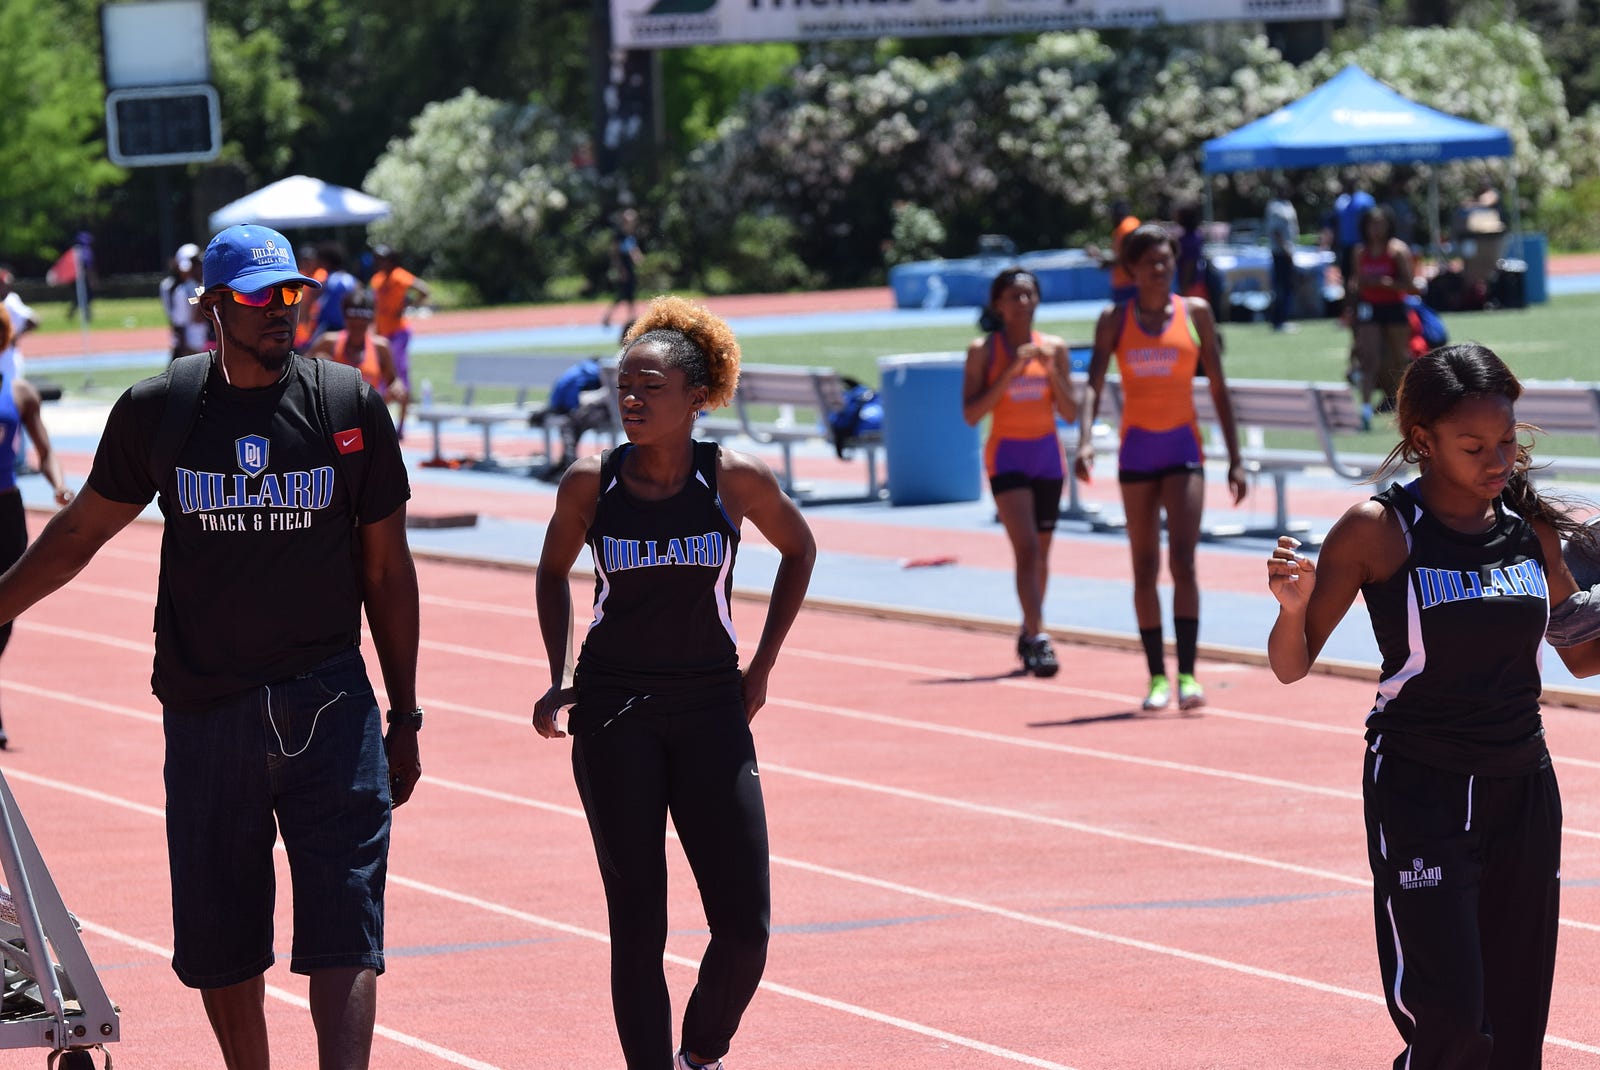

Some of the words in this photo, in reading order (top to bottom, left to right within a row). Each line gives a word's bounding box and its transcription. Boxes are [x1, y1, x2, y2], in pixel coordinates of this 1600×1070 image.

[251, 248, 289, 260] DILLARD
[176, 466, 335, 514] DILLARD
[200, 513, 247, 531] TRACK
[254, 513, 263, 531] &
[270, 511, 312, 531] FIELD
[603, 532, 723, 573] DILLARD
[1416, 559, 1546, 609] DILLARD
[1399, 866, 1441, 884] DILLARD
